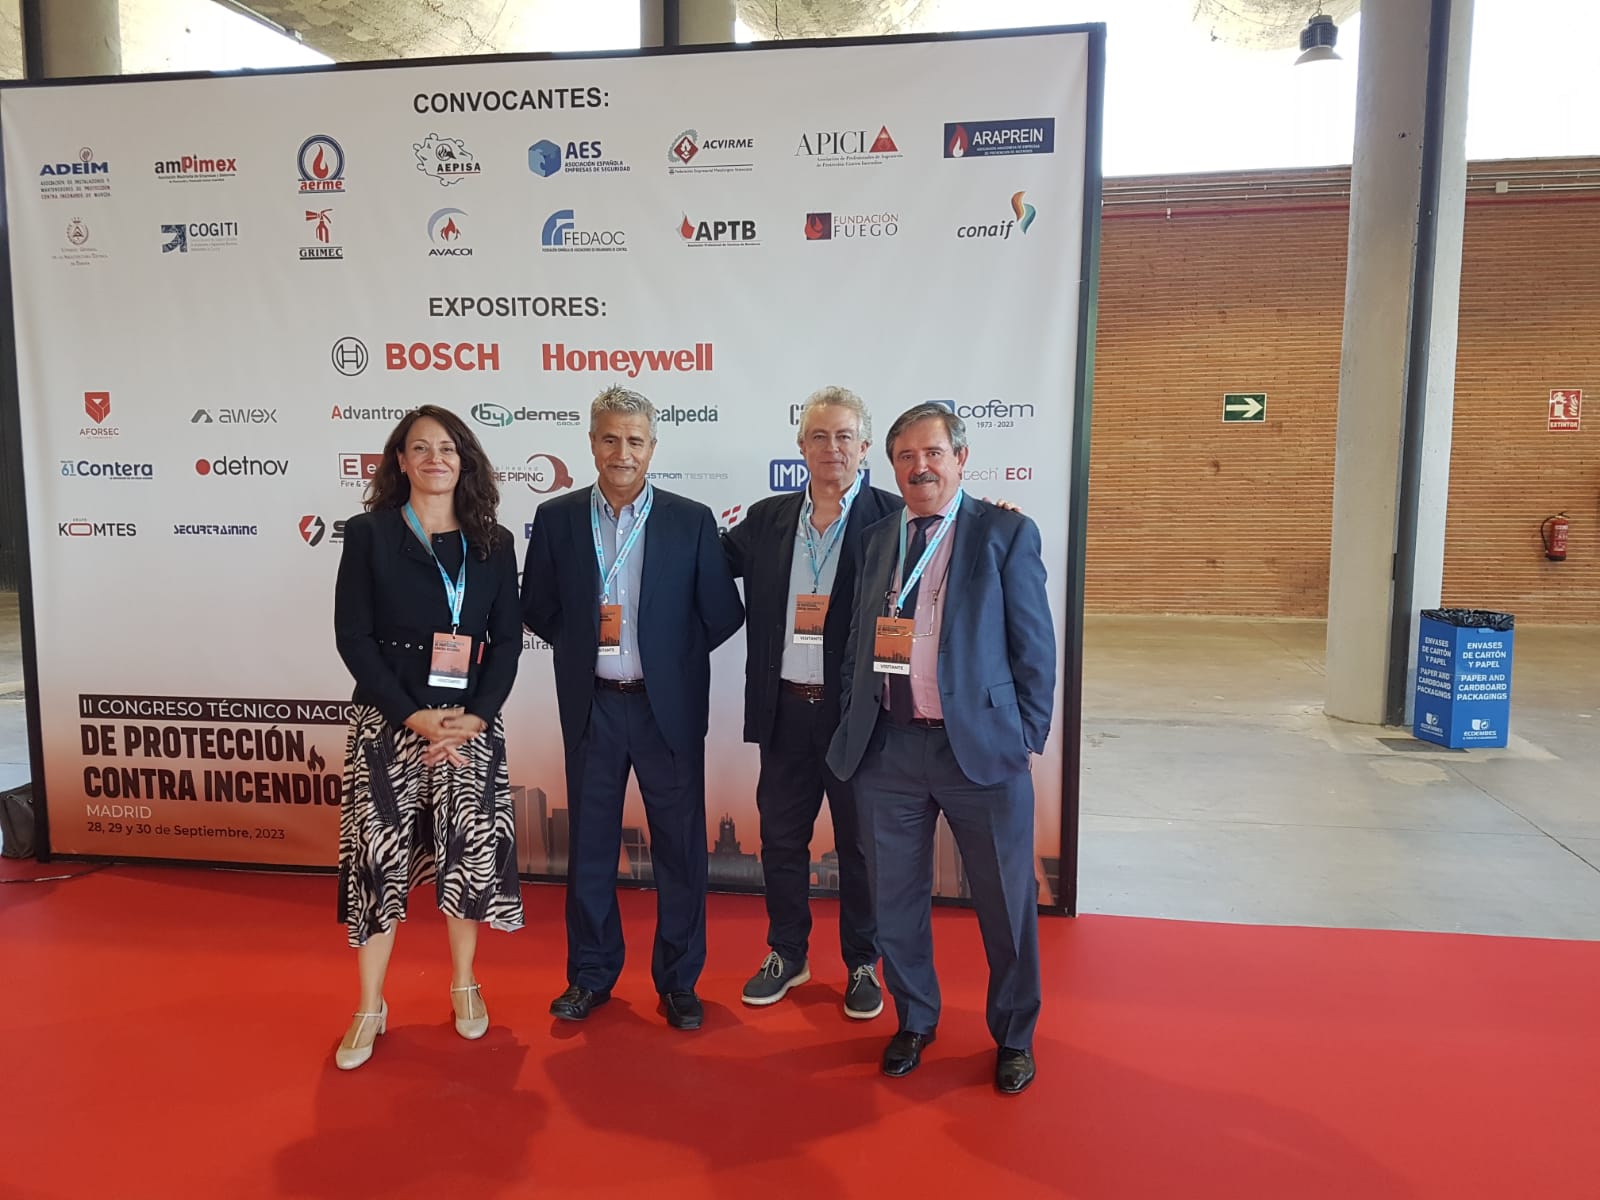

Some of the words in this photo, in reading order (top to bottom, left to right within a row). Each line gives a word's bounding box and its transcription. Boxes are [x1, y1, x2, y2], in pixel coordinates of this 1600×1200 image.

[413, 87, 609, 114] CONVOCANTES:
[702, 138, 754, 150] ACVIRME
[793, 130, 868, 156] APICI
[972, 127, 1044, 146] ARAPREIN
[565, 141, 602, 159] AES
[40, 162, 109, 176] ADEIM
[154, 155, 238, 174] amPimex
[437, 162, 481, 173] AEPISA
[300, 179, 343, 191] aerme
[833, 212, 899, 225] FUNDACIÓN
[189, 222, 238, 237] COGITI
[695, 220, 757, 241] APTB
[833, 223, 898, 238] FUEGO
[956, 220, 1015, 240] conaif
[564, 231, 625, 246] FEDAOC
[299, 247, 343, 257] GRIMEC
[428, 247, 473, 257] AVACOI
[429, 297, 607, 317] EXPOSITORES:
[385, 342, 500, 371] BOSCH
[542, 343, 713, 378] Honeywell
[514, 406, 581, 421] demes
[957, 399, 1034, 419] cofem
[79, 428, 120, 436] AFORSEC
[77, 460, 153, 477] Contera
[213, 456, 289, 476] detnov
[508, 472, 544, 482] PIPING
[644, 472, 683, 480] GSTROM
[774, 463, 809, 488] IMP
[961, 467, 998, 481] tech
[1005, 467, 1032, 481] ECI
[1467, 641, 1503, 650] ENVASES
[1462, 651, 1474, 659] DE
[1474, 650, 1507, 659] CARTÓN
[1475, 661, 1500, 669] PAPEL
[1460, 674, 1488, 682] PAPER
[1489, 674, 1505, 682] AND
[1458, 683, 1507, 691] CARDBOARD
[1456, 693, 1508, 701] PACKAGINGS
[82, 699, 93, 714] II
[98, 699, 203, 718] CONGRESO
[206, 700, 292, 719] TÉCNICO
[296, 704, 353, 721] NACIO
[80, 724, 117, 757] DE
[123, 725, 305, 763] PROTECCIÓN
[83, 766, 198, 801] CONTRA
[204, 770, 343, 806] INCENDIO
[86, 804, 152, 820] MADRID
[87, 821, 105, 833] 28,
[108, 822, 122, 833] 29
[126, 825, 133, 836] y
[136, 824, 151, 835] 30
[155, 824, 171, 835] de
[174, 825, 252, 840] Septiembre,
[255, 828, 286, 840] 2023
